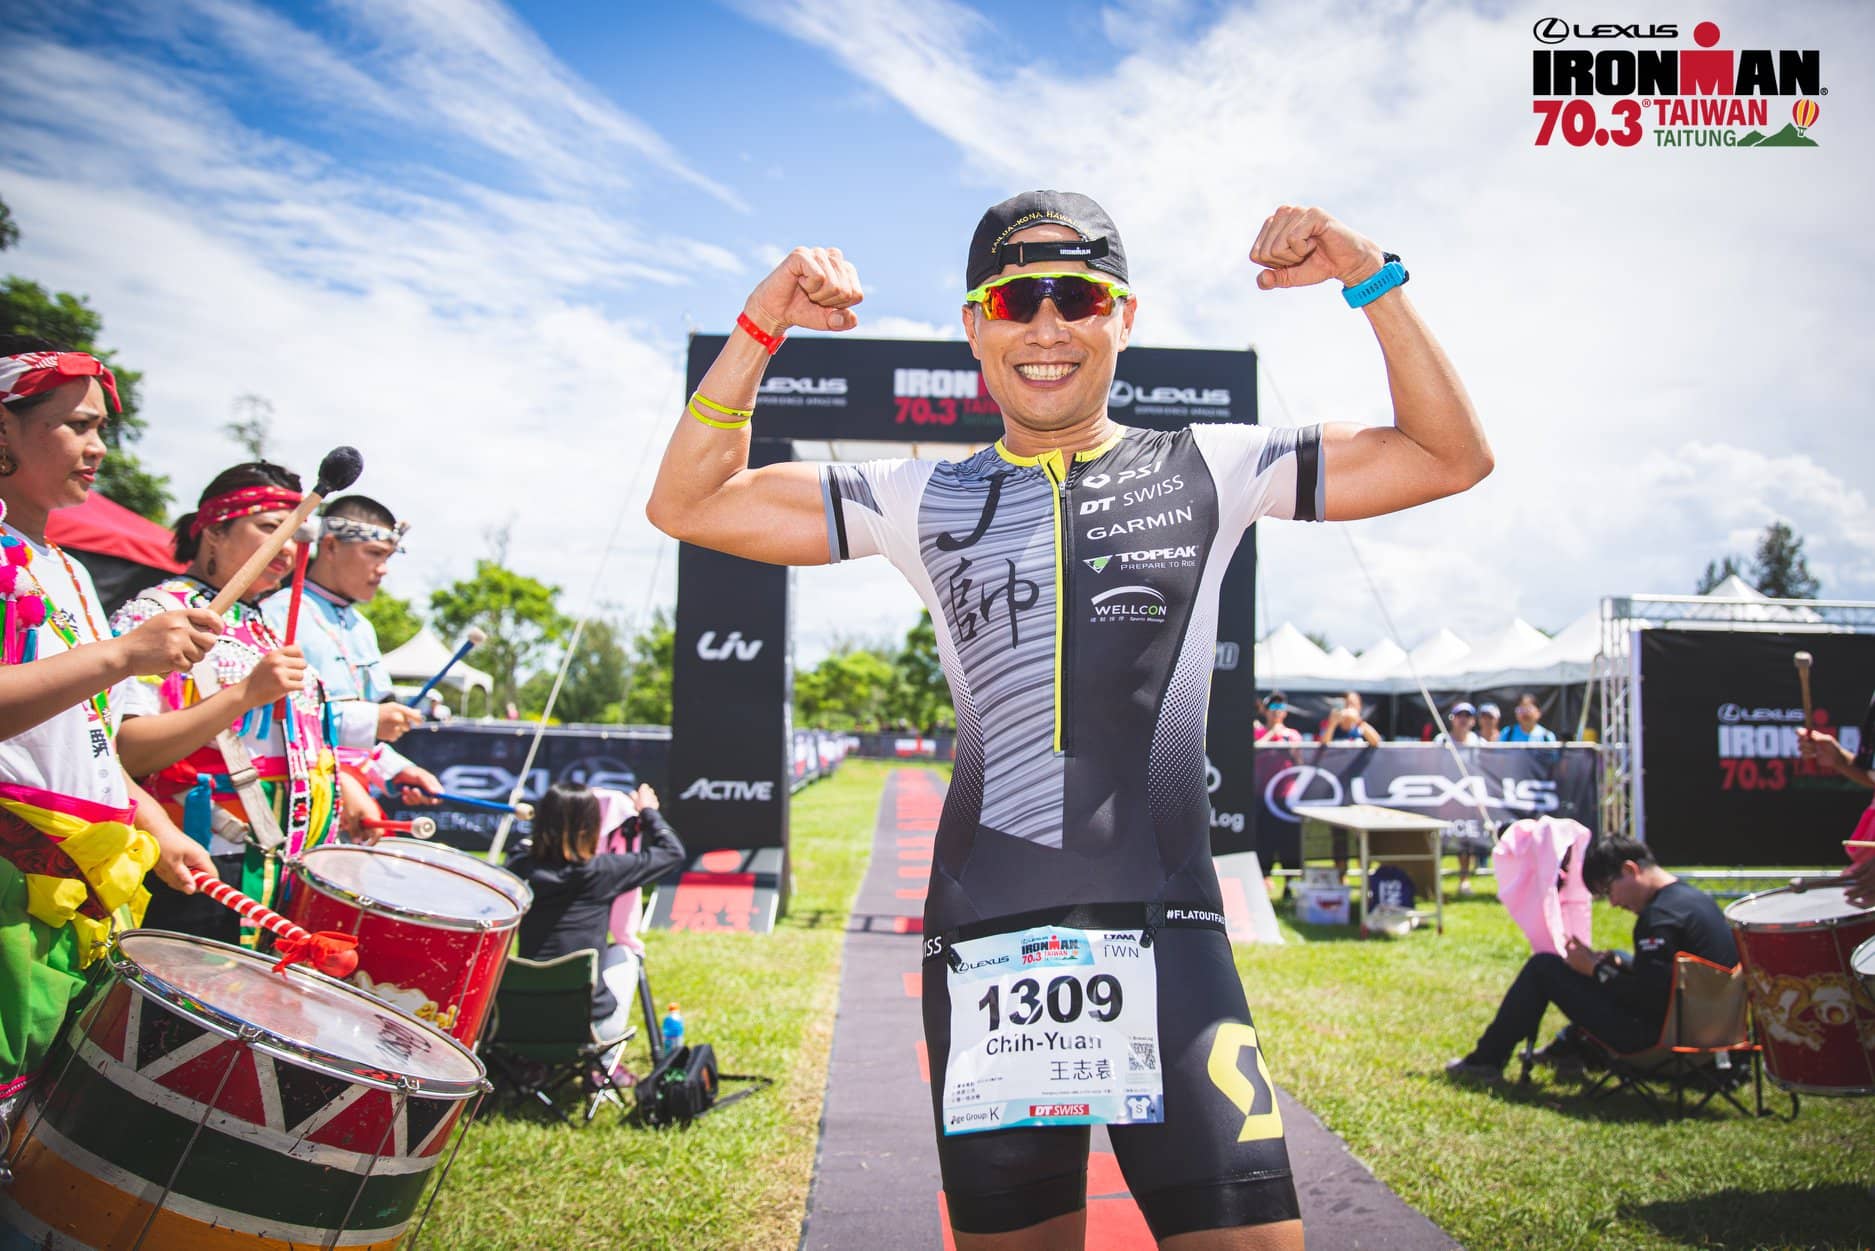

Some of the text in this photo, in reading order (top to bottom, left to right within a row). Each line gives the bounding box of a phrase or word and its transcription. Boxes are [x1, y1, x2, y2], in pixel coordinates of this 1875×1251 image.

[894, 368, 990, 398] IRON
[1134, 386, 1231, 405] LEXUS
[895, 397, 958, 425] 70.3
[1079, 474, 1184, 515] DT SWISS
[1086, 505, 1193, 540] GARMIN
[1115, 545, 1197, 563] TOPEAK
[1120, 562, 1166, 571] PREPARE
[1170, 560, 1180, 568] TO
[1094, 604, 1167, 616] WELLCON
[1719, 759, 1788, 792] 70.3
[680, 777, 774, 801] ACTIVE
[1350, 774, 1560, 812] LEXUS
[1021, 936, 1079, 955] IRONMAN
[970, 955, 1010, 970] LEXUS
[1021, 951, 1042, 965] 70.3
[978, 973, 1124, 1032] 1309
[986, 1031, 1102, 1056] Chih-Yuan
[989, 1106, 1000, 1121] K
[1035, 1104, 1085, 1116] DT SWISS
